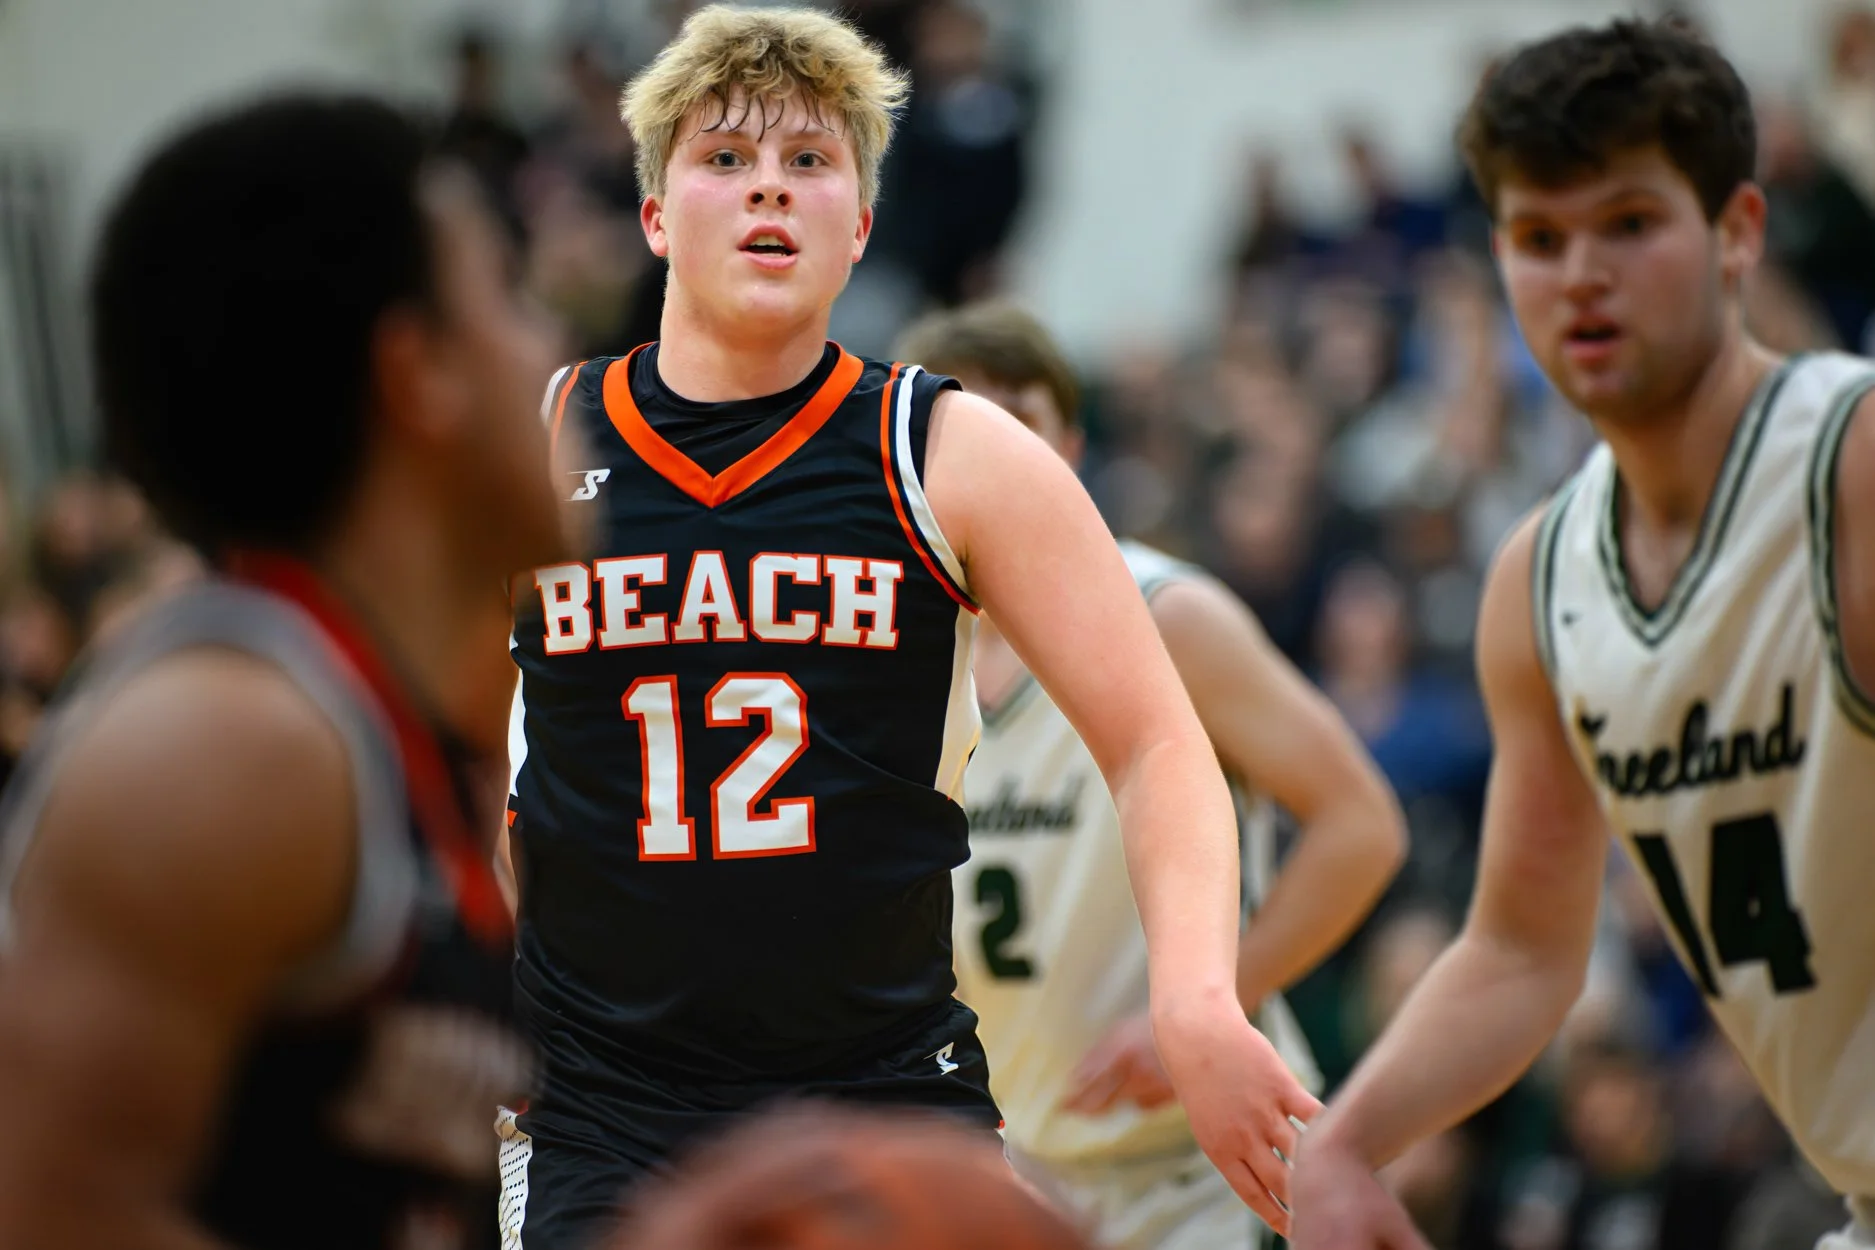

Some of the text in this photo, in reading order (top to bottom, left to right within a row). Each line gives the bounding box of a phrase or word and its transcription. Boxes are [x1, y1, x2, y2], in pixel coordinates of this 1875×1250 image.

[532, 550, 904, 656] BEACH
[621, 672, 817, 861] 12
[1580, 682, 1807, 797] reeland
[976, 866, 1037, 980] 2
[1633, 811, 1818, 1001] 14
